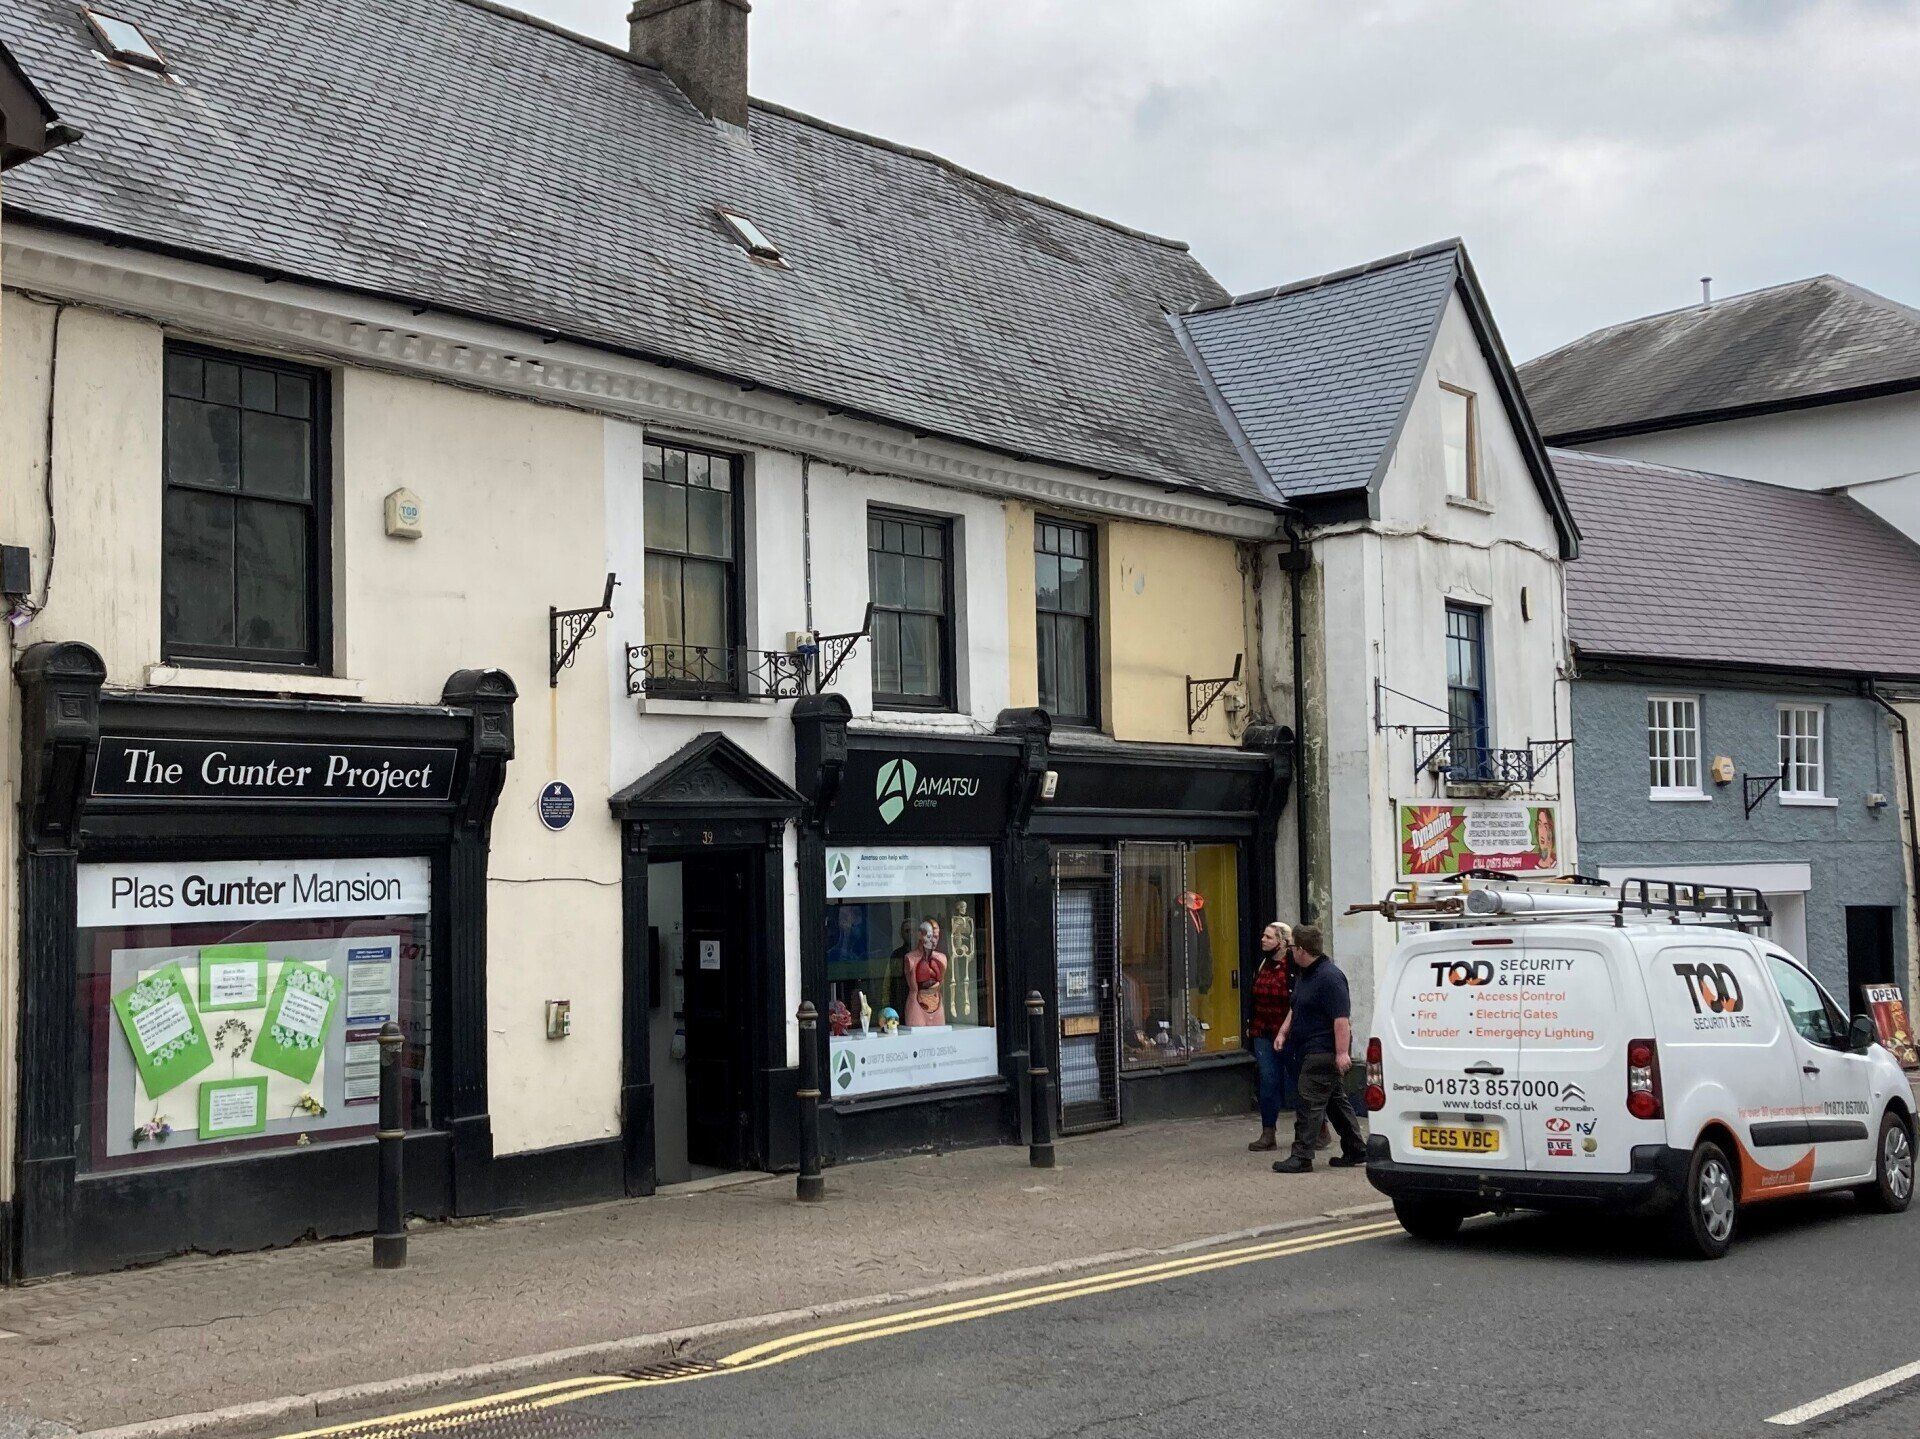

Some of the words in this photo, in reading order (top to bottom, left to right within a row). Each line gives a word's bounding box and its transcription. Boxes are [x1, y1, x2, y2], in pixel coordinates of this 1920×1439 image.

[123, 748, 183, 785] The
[201, 751, 312, 787] Gunter
[323, 755, 433, 796] Project
[916, 777, 980, 796] AMATSU
[913, 799, 938, 808] centre
[1411, 811, 1452, 850] Dynamite
[702, 831, 714, 845] 39
[112, 876, 174, 909] Plas
[182, 874, 286, 907] Gunter
[293, 872, 401, 904] Mansion
[1500, 959, 1575, 971] SECURITY
[1430, 960, 1494, 987] TOD
[1499, 975, 1508, 986] &
[1513, 975, 1545, 986] FIRE
[1672, 963, 1744, 1014] TOD
[1872, 988, 1899, 1001] OPEN
[1418, 992, 1449, 1003] CCTV
[1477, 991, 1518, 1001] Access
[1522, 991, 1566, 1001] Control
[1417, 1010, 1437, 1020] Fire
[1476, 1009, 1520, 1019] Electric
[1524, 1010, 1558, 1019] Gates
[1694, 1016, 1729, 1030] SECURITY
[1730, 1017, 1736, 1028] &
[1736, 1015, 1752, 1028] FIRE
[1417, 1028, 1460, 1037] Intruder
[1476, 1028, 1541, 1039] Emergency
[1544, 1028, 1595, 1040] Lighting
[1393, 1083, 1423, 1094] Berlingo
[1425, 1078, 1480, 1095] 01873
[1486, 1080, 1559, 1098] 857000
[1442, 1100, 1539, 1111] www.todsf.co.uk
[1824, 1101, 1844, 1115] 01873
[1846, 1101, 1870, 1115] 857000
[1419, 1129, 1458, 1146] CE65
[1462, 1131, 1493, 1148] VBC
